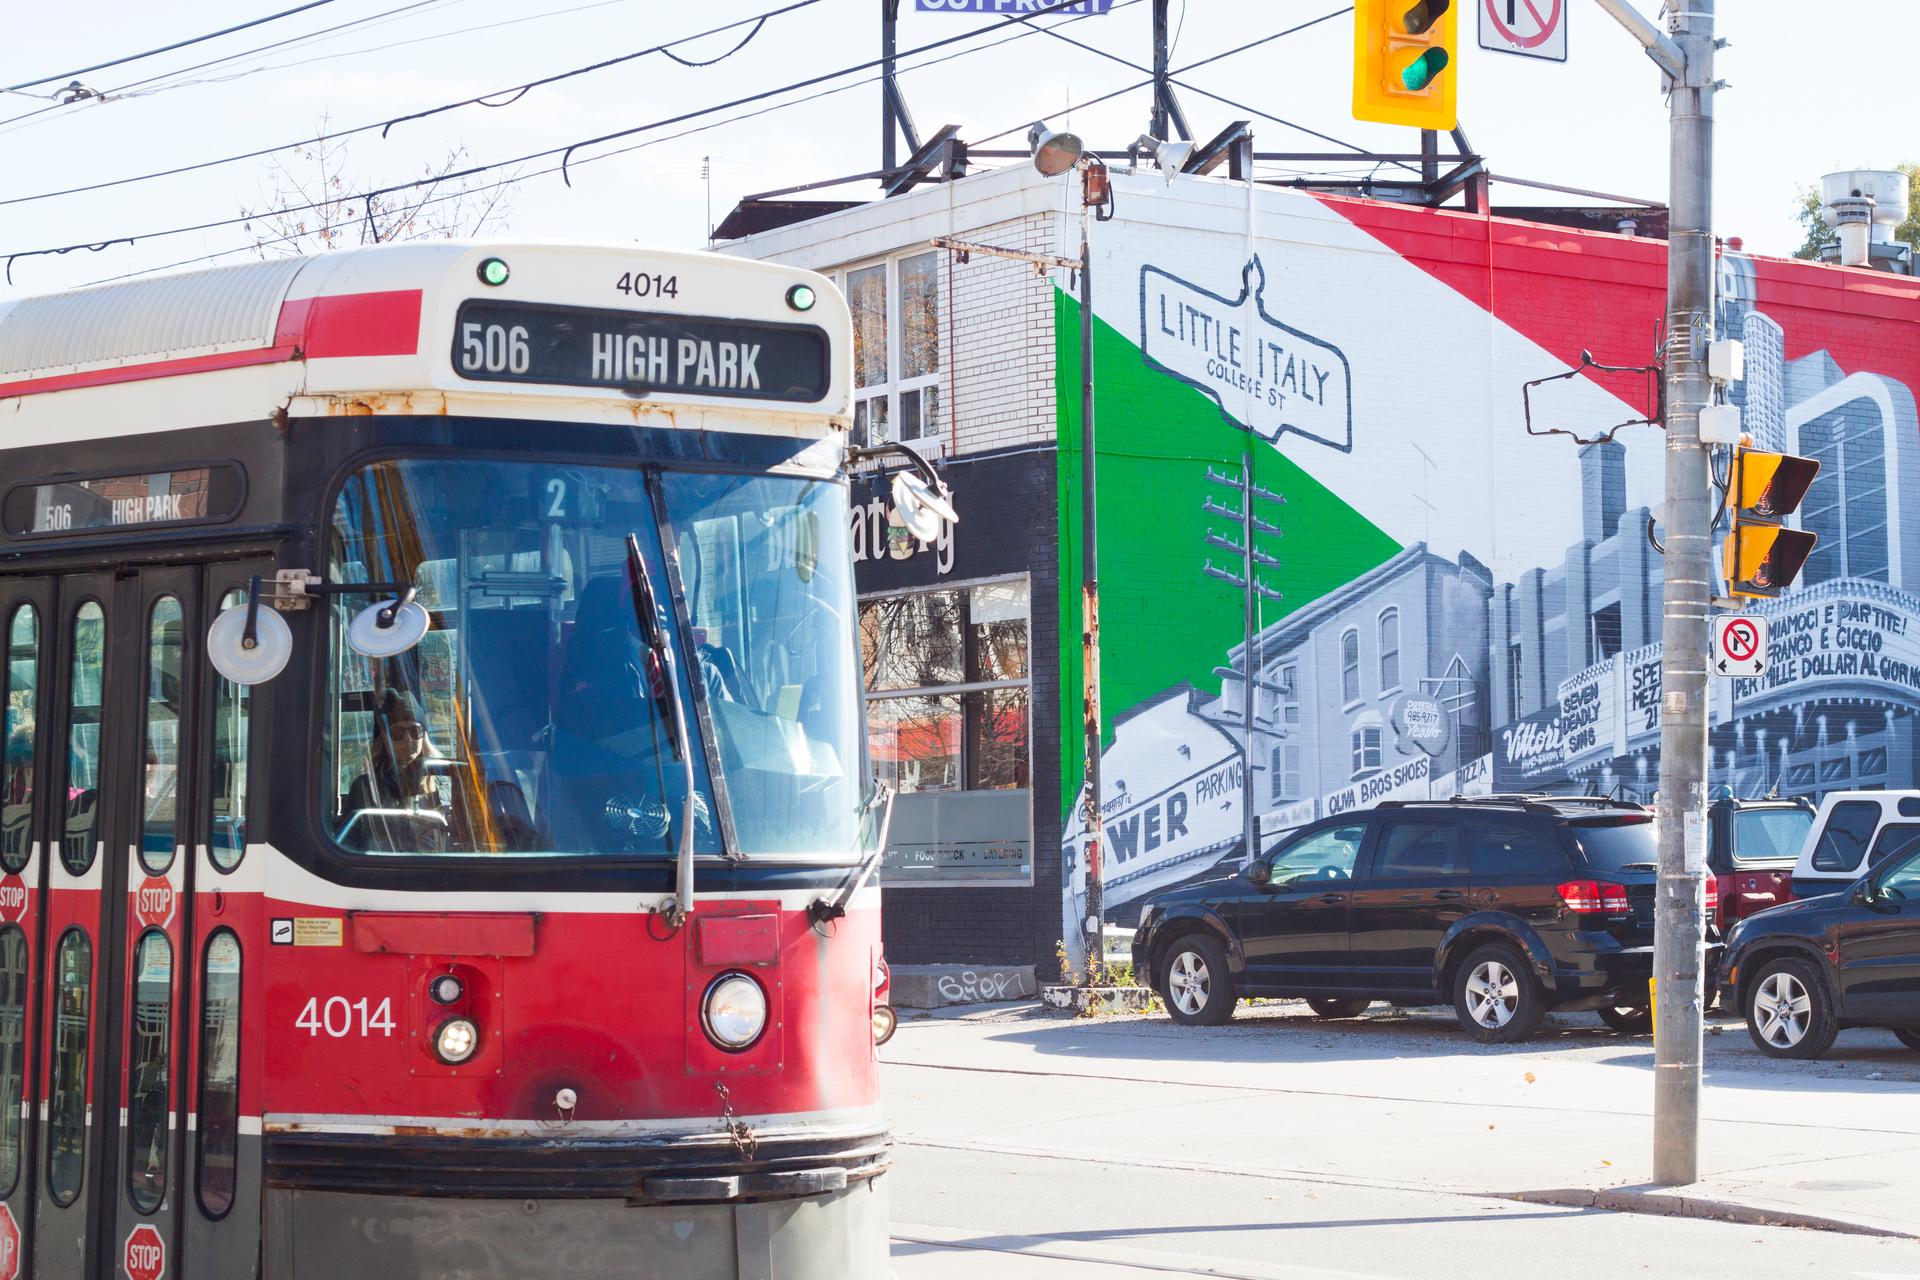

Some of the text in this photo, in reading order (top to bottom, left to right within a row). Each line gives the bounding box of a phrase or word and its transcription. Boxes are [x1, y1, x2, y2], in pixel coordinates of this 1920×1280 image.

[616, 272, 679, 299] 4014
[462, 322, 762, 391] 506 HIGH PARK
[1160, 293, 1330, 407] LITTLE ITALY
[1206, 358, 1287, 411] COLLEGE ST
[46, 493, 182, 531] 506 HIGH PARK
[546, 477, 567, 518] 2
[1824, 605, 1834, 624] E
[1837, 600, 1907, 636] PARTITE!
[1768, 627, 1883, 666] FRANCO E CICCIO
[1801, 652, 1858, 679] DOLLARI
[1860, 652, 1879, 676] AL
[1563, 681, 1599, 714] SEVEN
[1562, 701, 1602, 736] DEADLY
[1644, 705, 1659, 731] 21
[1569, 726, 1597, 753] SINS
[1196, 761, 1243, 806] PARKING
[1328, 788, 1356, 816] OLIVA
[1361, 774, 1393, 804] BROS
[1394, 757, 1429, 787] SHOES
[1456, 757, 1488, 785] PIZZA
[1062, 791, 1190, 890] PWER
[141, 888, 171, 913] STOP
[295, 995, 397, 1037] 4014
[129, 1244, 161, 1271] STOP
